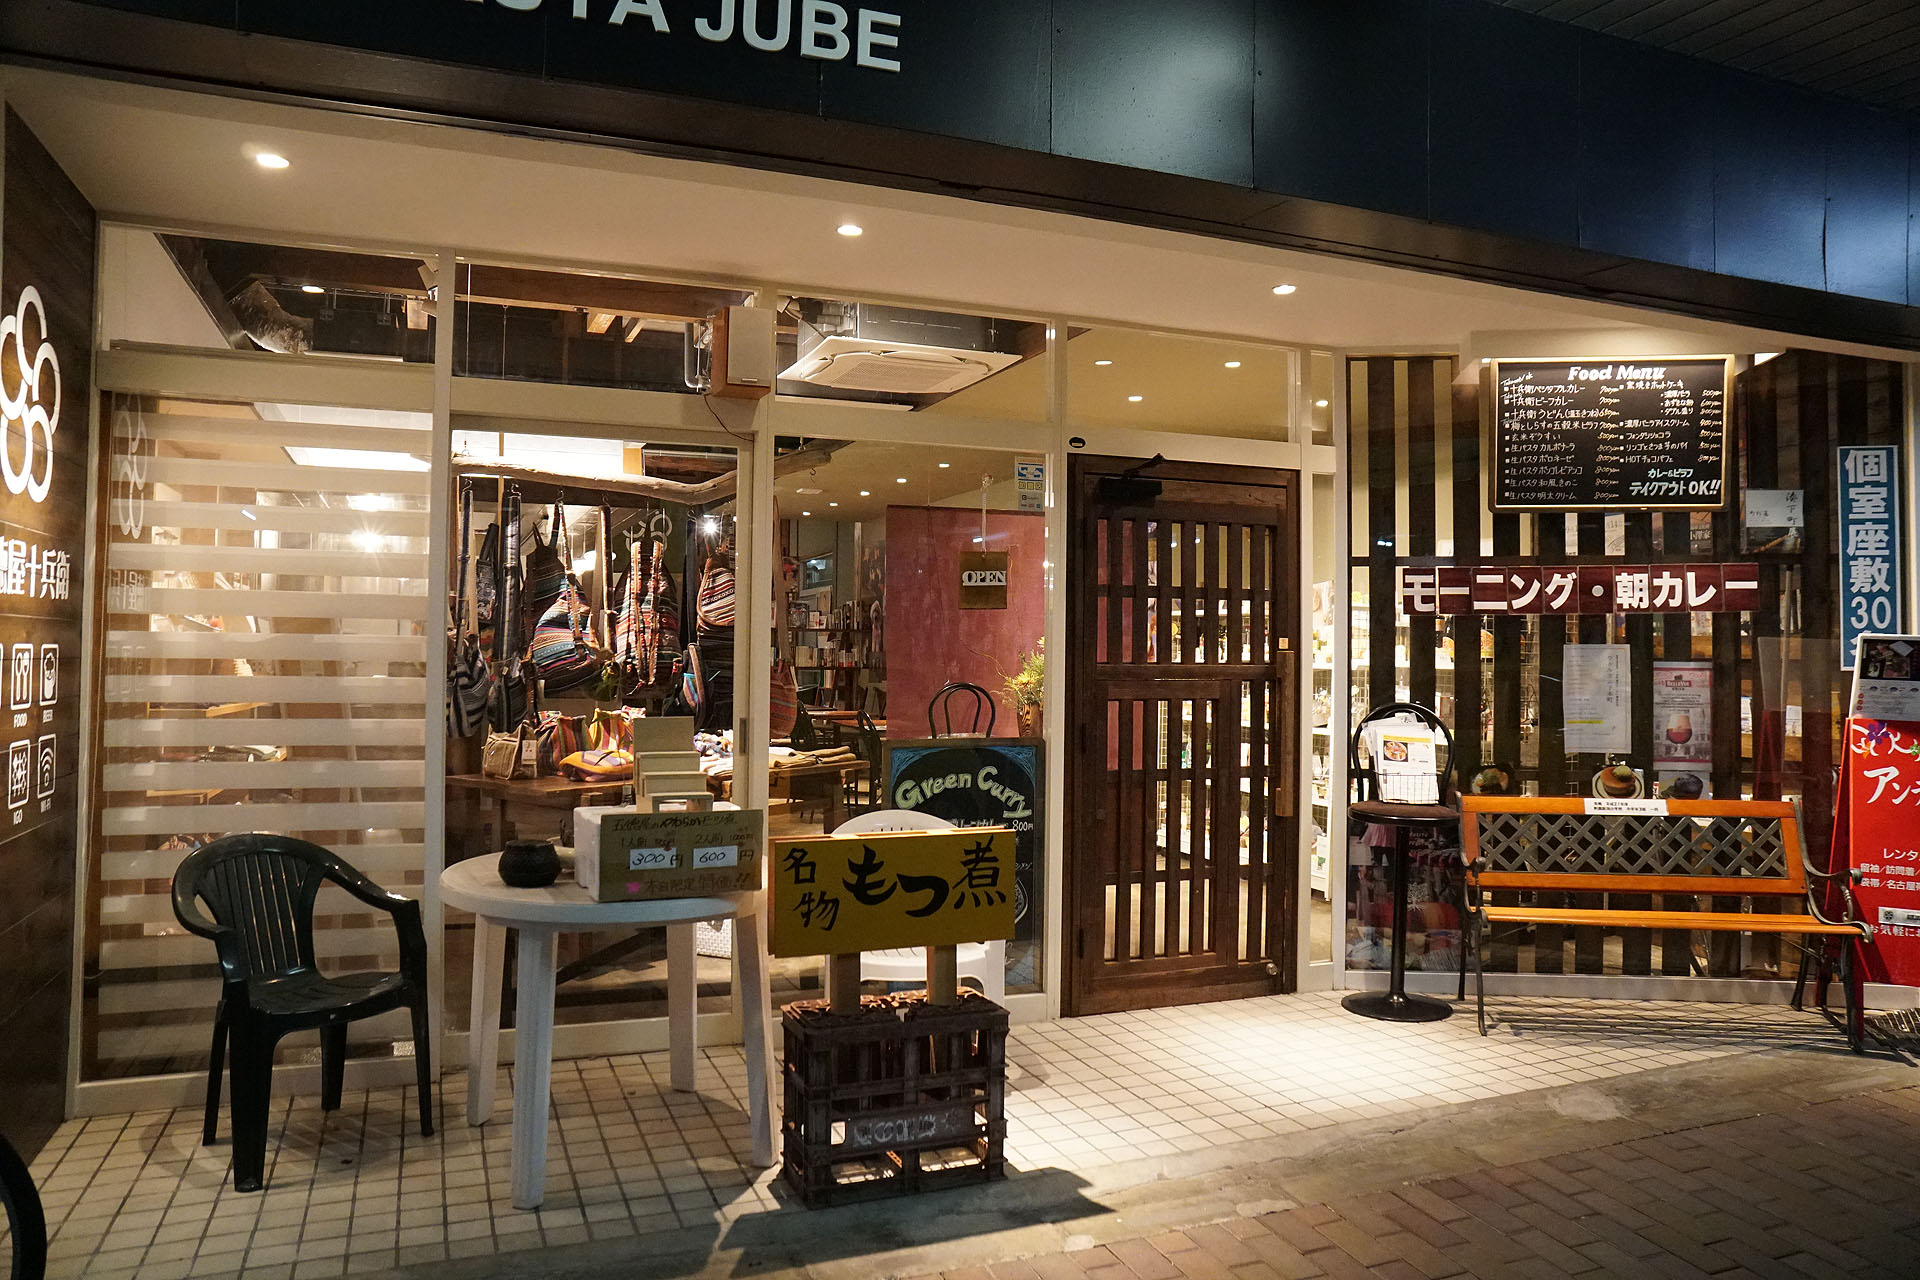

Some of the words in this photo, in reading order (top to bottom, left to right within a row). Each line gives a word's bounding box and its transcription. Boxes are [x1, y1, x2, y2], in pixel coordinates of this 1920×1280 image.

[694, 0, 902, 73] JUBE
[1567, 365, 1613, 381] Food
[1616, 365, 1667, 380] Menu
[1647, 468, 1694, 479] カレー&ピラフ
[1844, 449, 1892, 657] 個室座敷30
[962, 570, 1007, 586] OPEN
[1402, 571, 1759, 613] モーニング・朝カレー
[13, 712, 28, 728] FOOD
[894, 773, 973, 810] Green
[977, 765, 1033, 819] Curry
[1883, 848, 1920, 862] レンタ
[782, 847, 840, 932] 名物
[842, 834, 1007, 919] もつ煮
